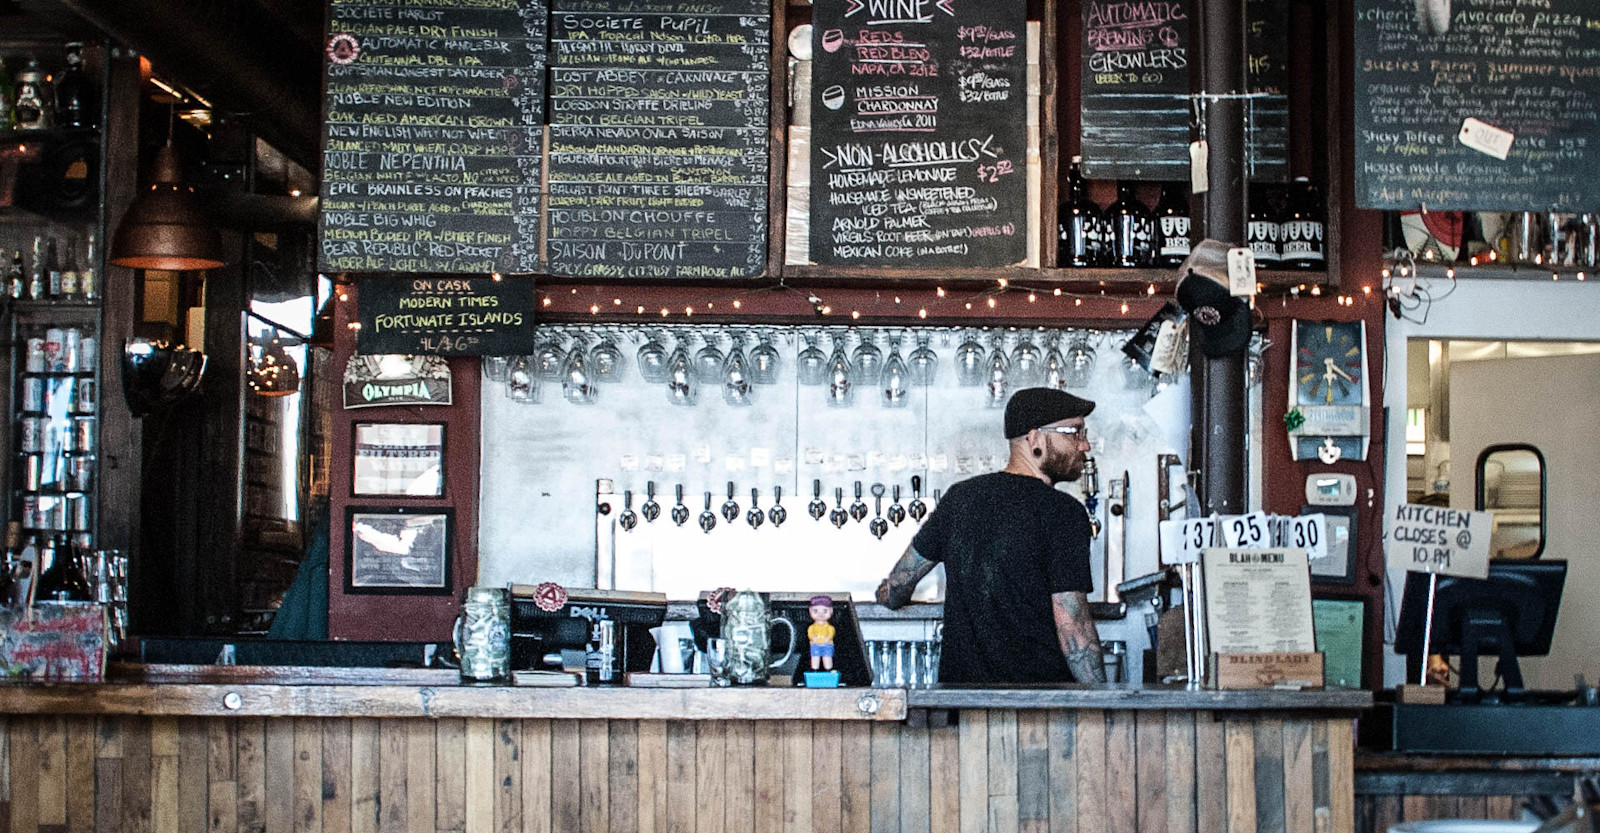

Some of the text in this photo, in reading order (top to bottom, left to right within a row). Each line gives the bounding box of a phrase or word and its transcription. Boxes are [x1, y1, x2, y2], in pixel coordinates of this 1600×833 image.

[336, 7, 393, 19] SOCIETE
[867, 0, 933, 20] WINE
[1087, 1, 1188, 27] AUTOMATIC
[1455, 8, 1526, 25] Avocado
[331, 20, 383, 35] BELGIAN
[420, 25, 446, 38] DRY
[451, 26, 498, 38] FINISH
[362, 37, 438, 50] AUTOMATIC
[600, 31, 644, 42] Tropical
[859, 29, 904, 44] REDS
[360, 54, 483, 66] CENTENNIAL DBL IPA
[857, 47, 931, 61] RED BLEND
[1088, 48, 1188, 72] GROWLERS
[394, 67, 444, 78] LONGEST
[447, 69, 470, 78] DAY
[554, 69, 738, 84] LOST ABBEY CARNIVALE
[909, 64, 938, 77] 2012
[555, 84, 744, 100] DRY HOPPED YEAST
[856, 85, 919, 98] MISSION
[334, 92, 471, 109] NOBLE NEW EDITION
[857, 98, 938, 112] CHARDONNAY
[400, 114, 514, 127] AMERICAN BROWN
[556, 113, 704, 126] SPICY BELGIAN TRIPEL
[915, 113, 936, 127] 2011
[329, 125, 359, 137] NEW
[362, 125, 411, 139] ENGLISH
[442, 129, 465, 140] NOT
[466, 128, 508, 140] WHEAT
[552, 126, 724, 139] SIERRA NEVADA OVILA SAISON
[552, 142, 586, 153] SAISON
[324, 151, 368, 170] NOBLE
[605, 173, 623, 183] ALE
[624, 173, 652, 182] AGED
[828, 167, 958, 189] HOUSEMADE LEMONADE
[330, 183, 359, 196] EPIC
[367, 184, 441, 196] BRAINLESS
[444, 187, 461, 197] ON
[464, 187, 513, 199] PEACHES
[632, 185, 670, 196] THREE
[674, 185, 713, 196] SHEETS
[830, 186, 976, 206] HOUSEMADE UNSWEETENED
[862, 203, 888, 216] ICED
[891, 202, 916, 213] TEA
[325, 212, 437, 228] NOBLE BIG WHIG
[552, 210, 716, 225] HOUBLON CHOUFFE
[831, 215, 931, 231] ARNOLD PALMER
[324, 229, 368, 240] MEDIUM
[415, 229, 433, 243] IPA
[477, 231, 511, 243] FINISH
[552, 227, 733, 241] HOPPY BELGIAN TRIPEL
[876, 229, 901, 242] ROOT
[322, 239, 359, 256] BEAR
[363, 240, 421, 257] REPUBLIC
[429, 241, 454, 257] RED
[455, 241, 502, 258] ROCKET
[1164, 237, 1191, 248] BEE
[1283, 241, 1311, 252] BEER
[551, 241, 606, 261] SAISON
[833, 245, 914, 259] MEXICAN COKE
[731, 265, 745, 276] ALE
[413, 279, 472, 291] ON CASK
[399, 295, 499, 309] MODERN TIMES
[375, 312, 523, 333] FORTUNATE ISLANDS
[362, 380, 432, 402] OLYMPIA
[1396, 504, 1471, 529] KITCHEN
[1194, 521, 1215, 549] 37
[1233, 514, 1261, 547] 25
[1294, 519, 1318, 548] 30
[1394, 526, 1472, 549] CLOSES @
[1229, 552, 1285, 563] BLAH MENU
[1413, 547, 1451, 567] 10 PM
[570, 605, 608, 619] DELL
